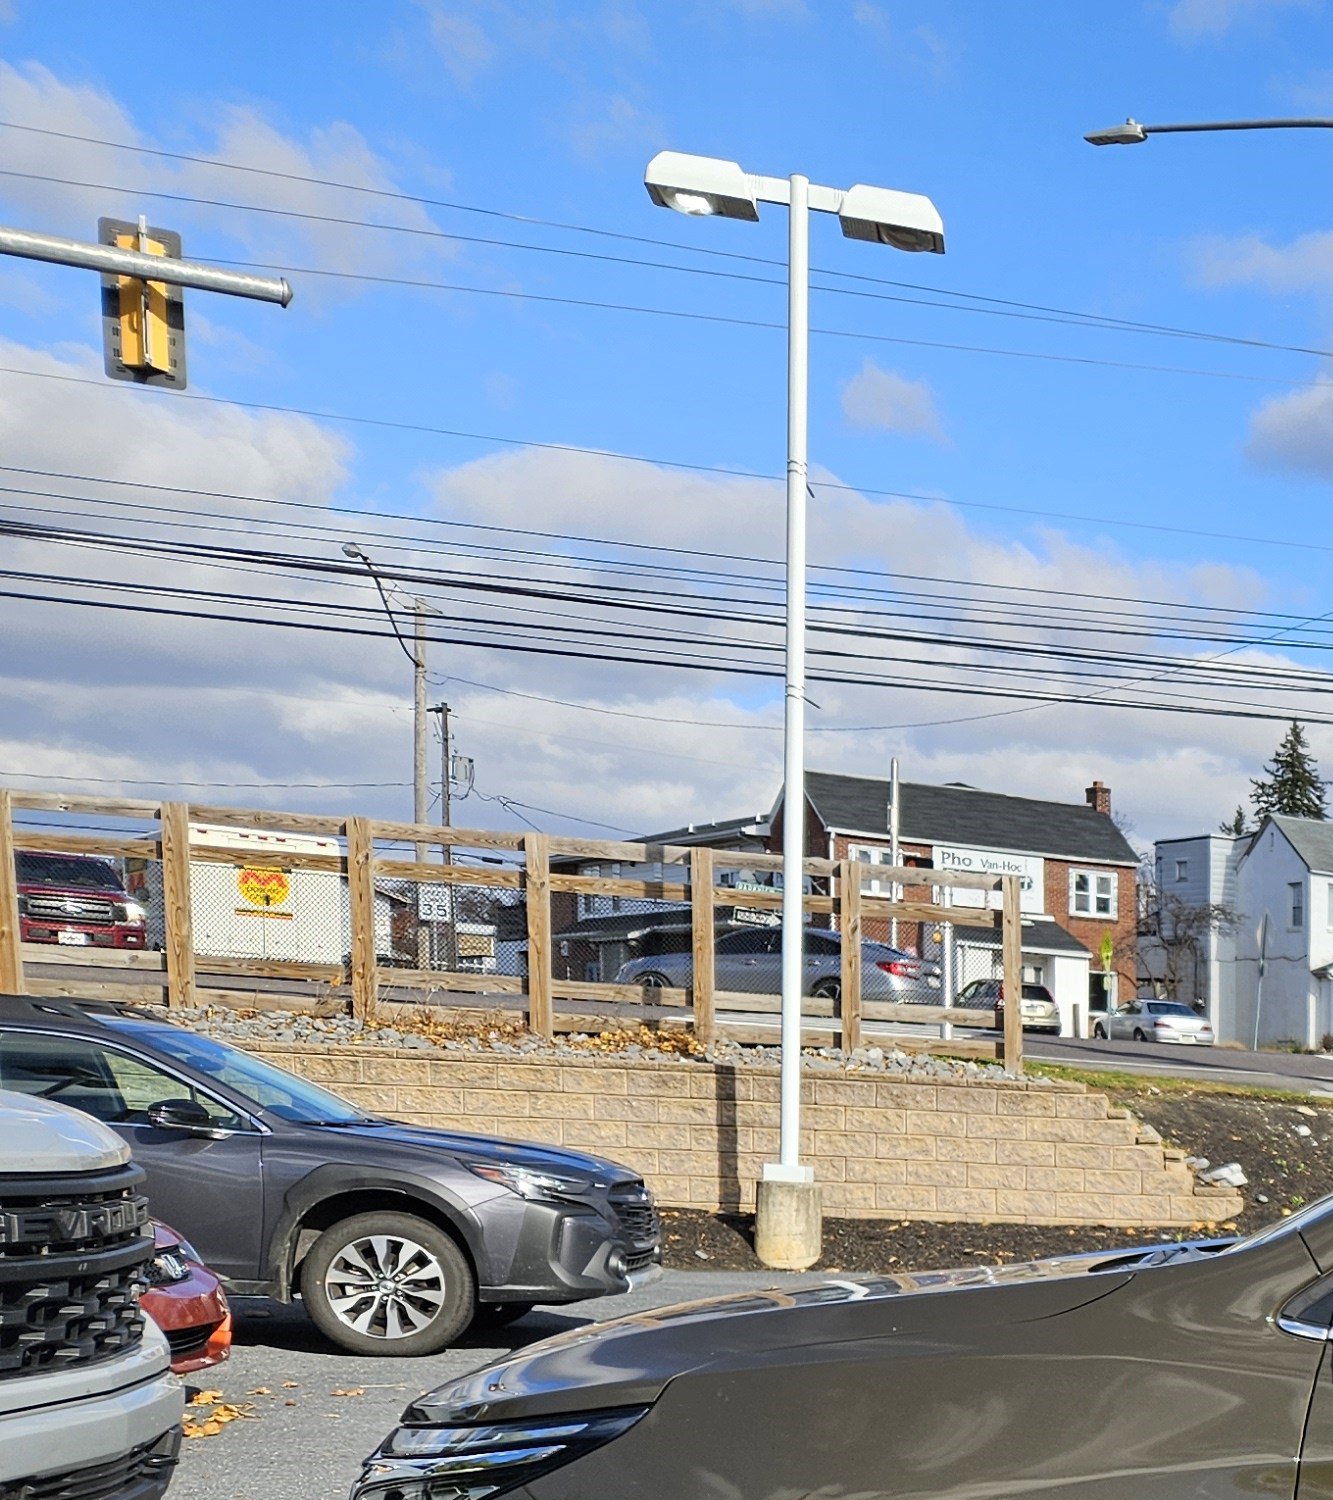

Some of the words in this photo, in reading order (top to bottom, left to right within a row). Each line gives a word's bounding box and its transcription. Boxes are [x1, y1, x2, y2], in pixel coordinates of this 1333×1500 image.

[941, 850, 972, 867] Pho
[980, 858, 1022, 873] Van-Hoc
[422, 903, 447, 917] 35
